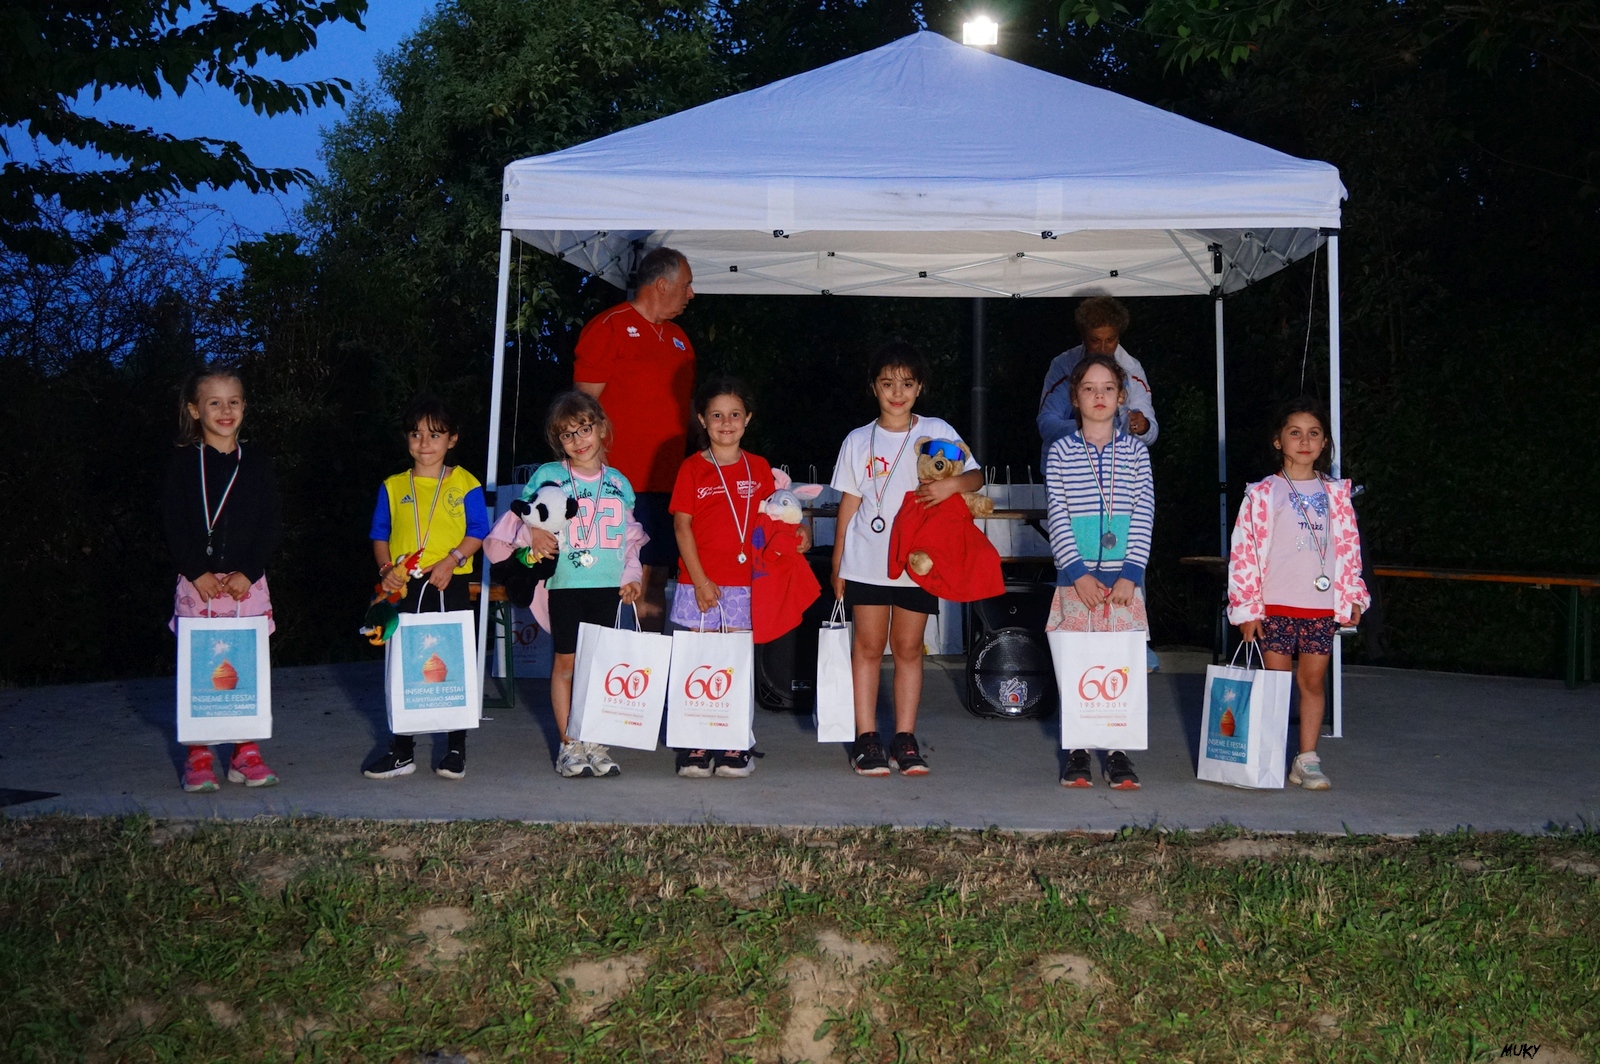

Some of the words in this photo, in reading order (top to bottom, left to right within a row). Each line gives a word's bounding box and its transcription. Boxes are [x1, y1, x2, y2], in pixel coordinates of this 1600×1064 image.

[568, 497, 623, 549] 82
[405, 687, 434, 695] INSIEME
[436, 686, 440, 694] È
[225, 694, 230, 702] È
[603, 696, 647, 708] 1959-2019
